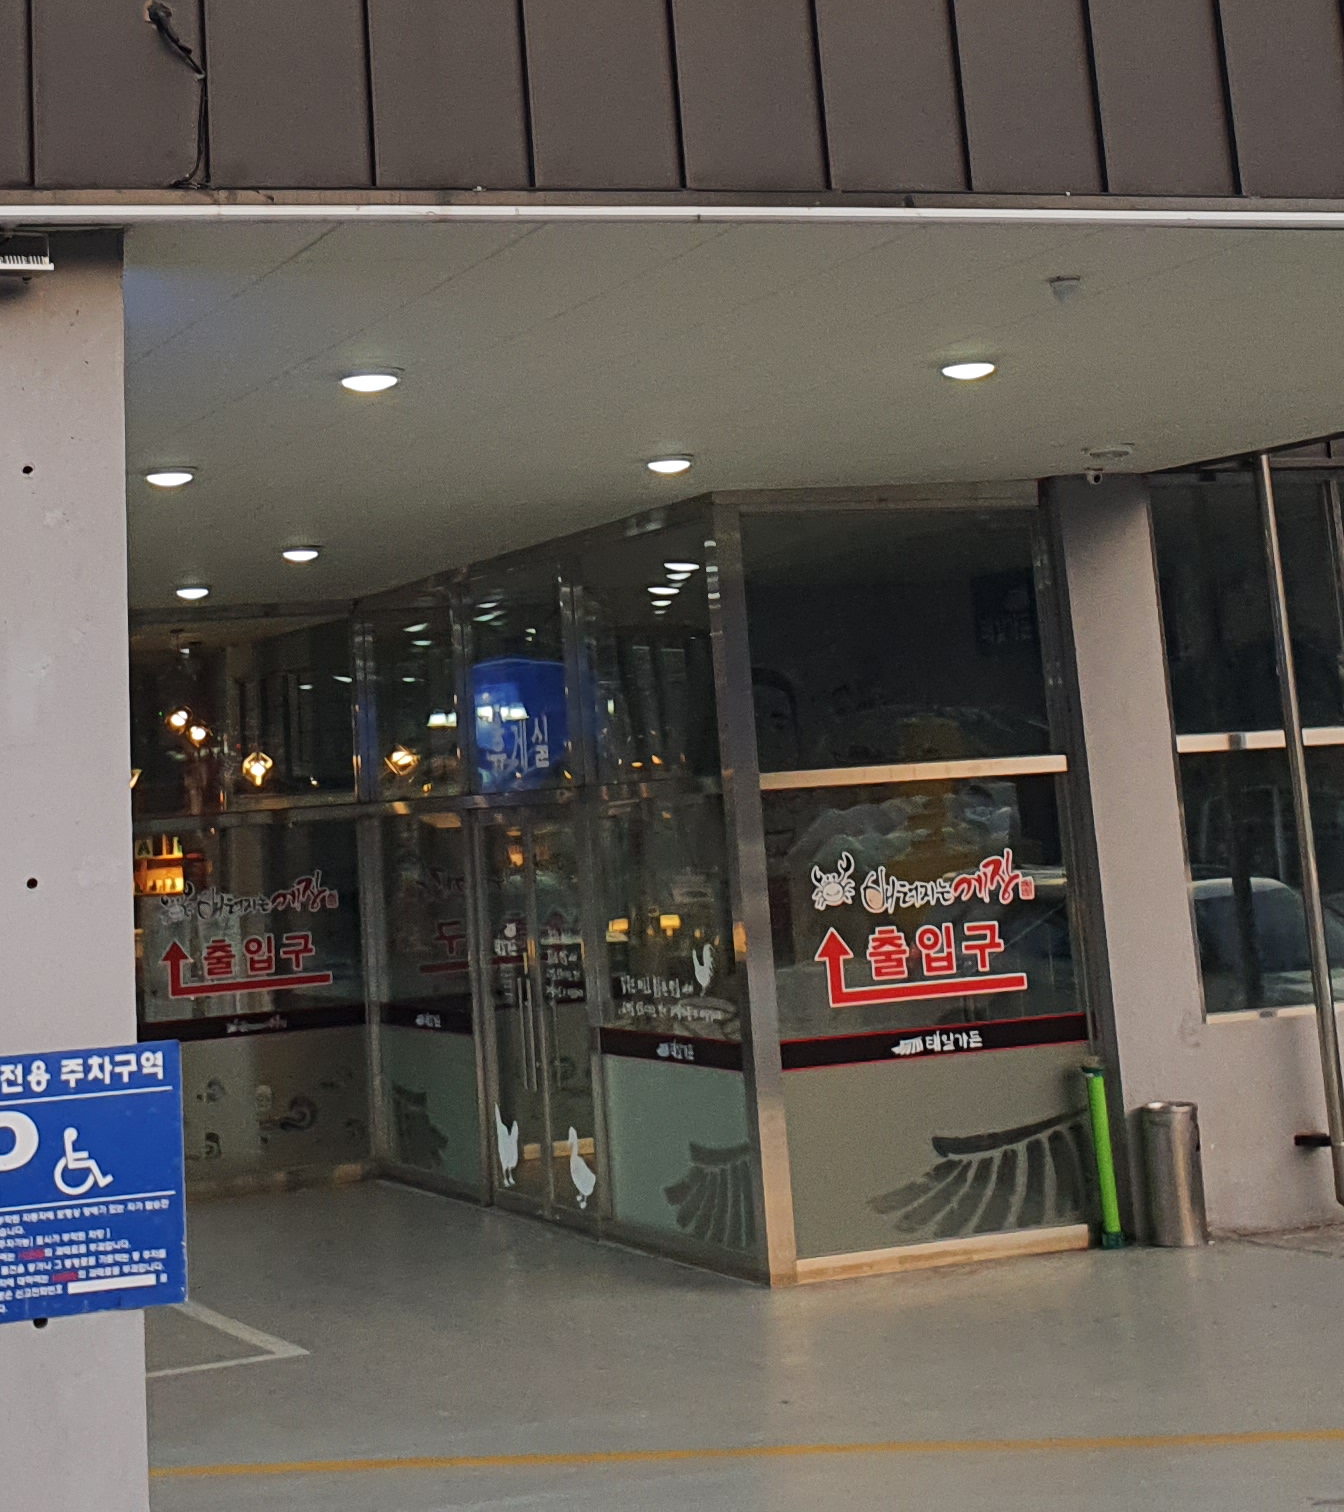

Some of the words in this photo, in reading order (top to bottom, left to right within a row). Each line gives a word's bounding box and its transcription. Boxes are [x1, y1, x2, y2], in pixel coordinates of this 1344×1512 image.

[203, 931, 315, 979] 출입구
[867, 920, 1004, 980] 출입구
[0, 1059, 51, 1094] 전용
[60, 1050, 164, 1088] 주차구역
